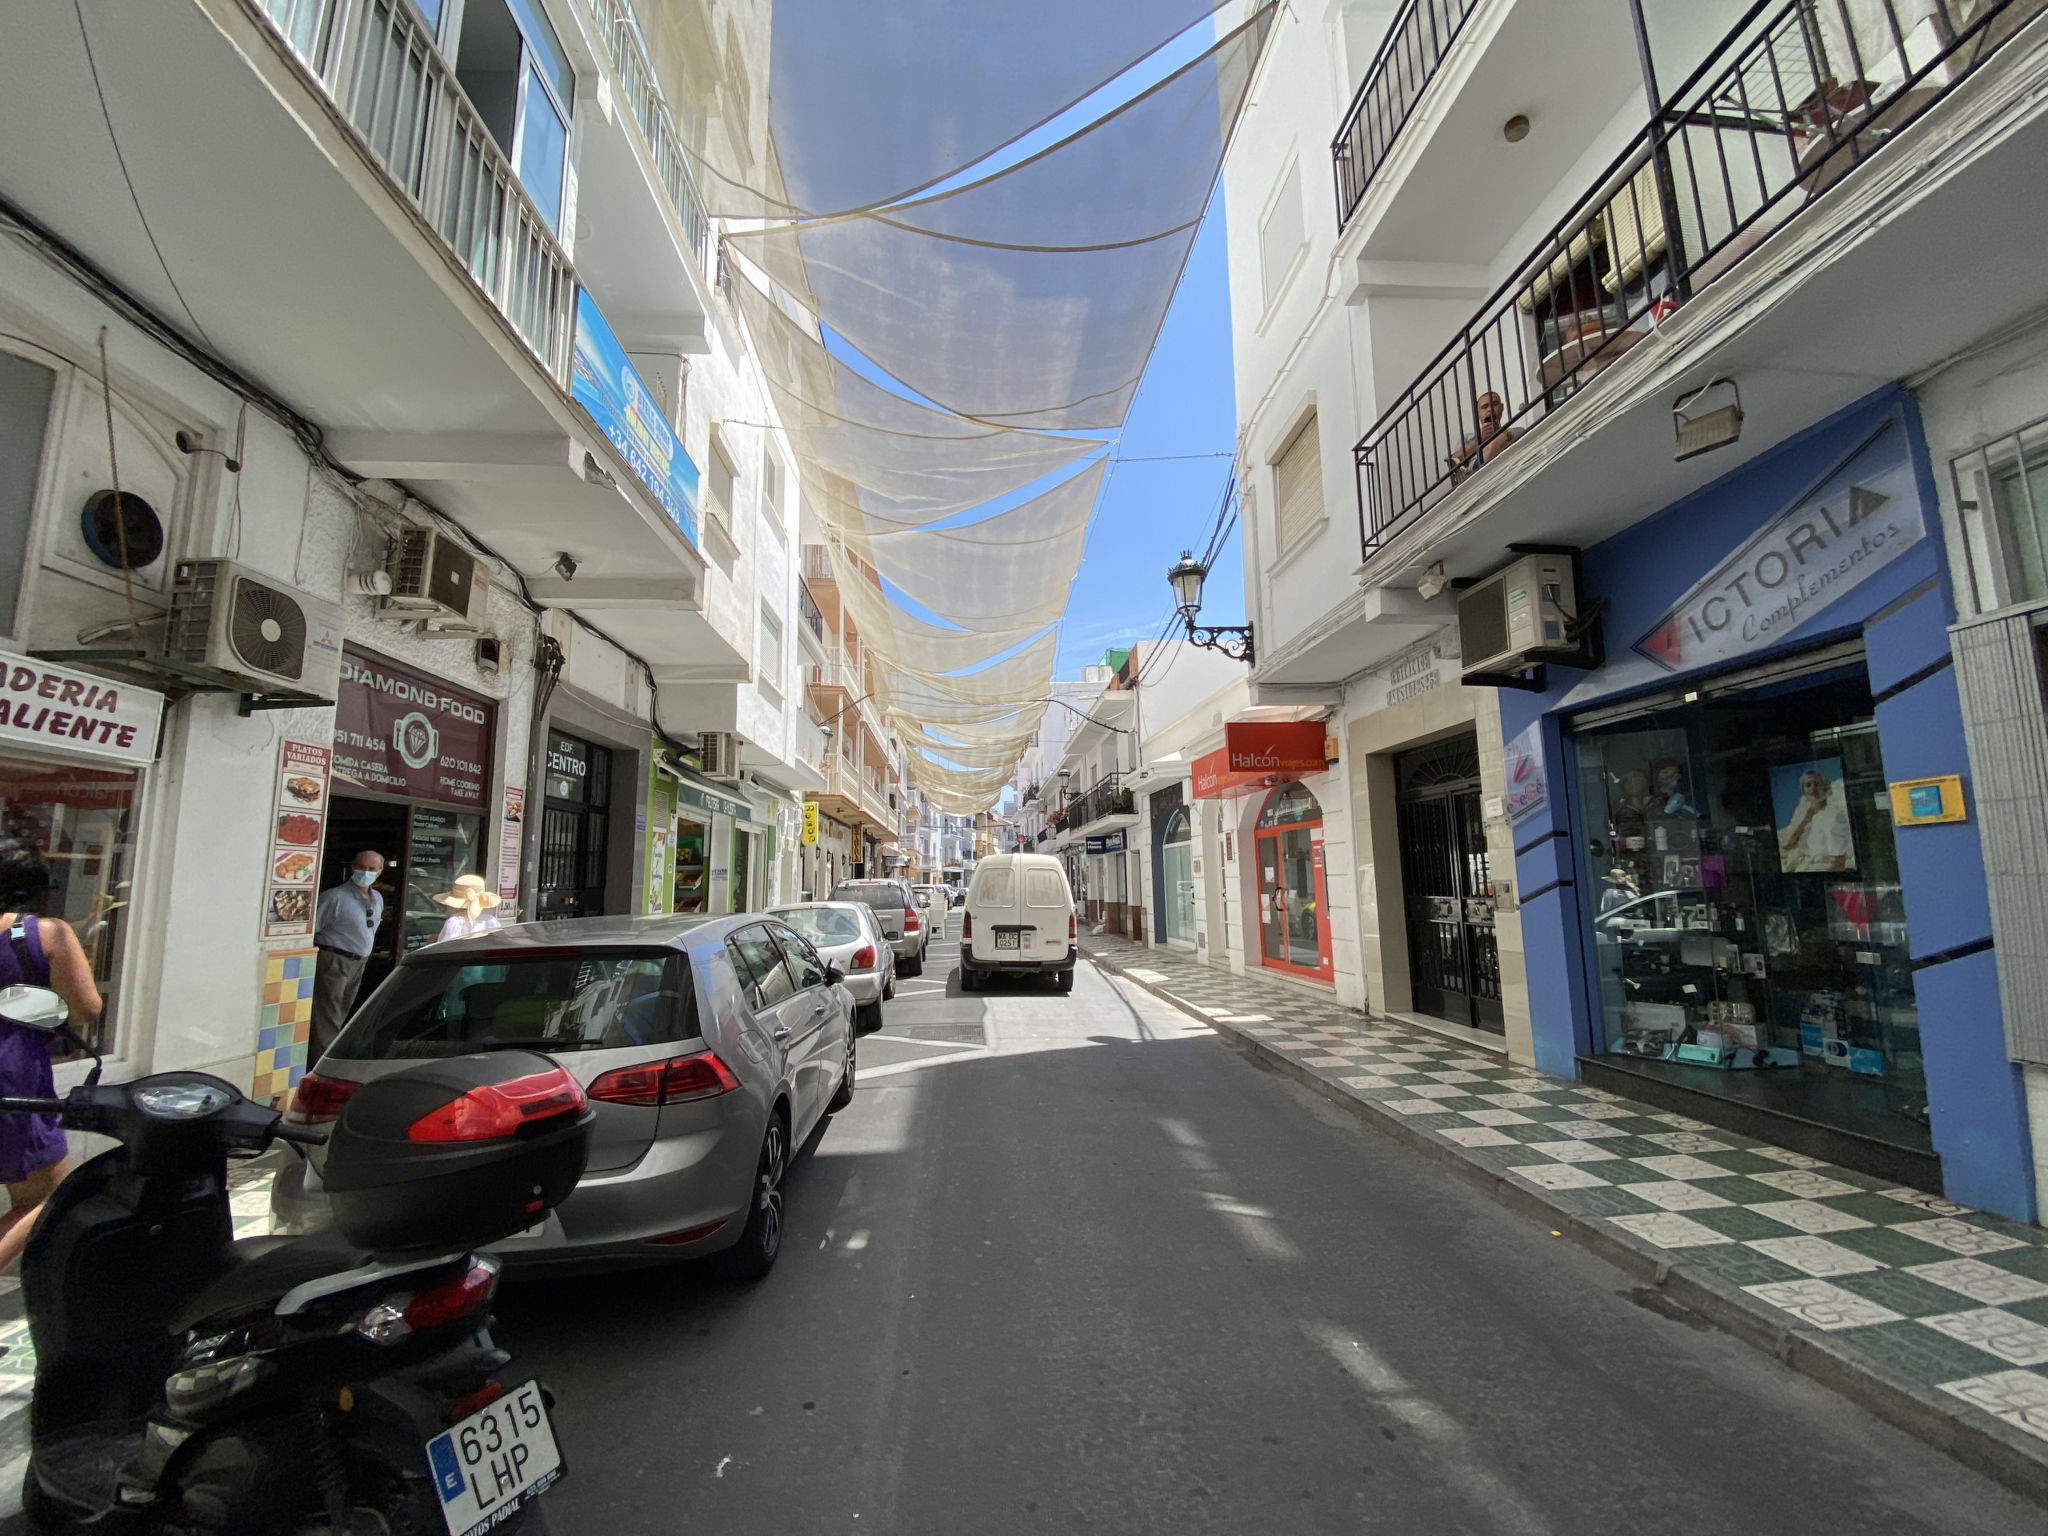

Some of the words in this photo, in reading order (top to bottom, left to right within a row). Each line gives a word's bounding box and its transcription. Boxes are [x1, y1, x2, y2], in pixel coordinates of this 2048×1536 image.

[608, 424, 628, 457] +34
[630, 450, 648, 481] 642
[649, 474, 665, 507] 194
[1741, 522, 1901, 643] Complementos
[440, 698, 485, 724] FOOD
[292, 744, 323, 756] PLATOS
[351, 733, 363, 747] 711
[366, 736, 386, 752] 454
[287, 751, 327, 765] VARIADOS
[333, 755, 359, 768] OMIDA
[361, 758, 388, 774] CASERA
[333, 766, 363, 779] NTREGA
[460, 1391, 540, 1465] 6315
[445, 1471, 457, 1489] E
[470, 1443, 529, 1510] LHP
[463, 1518, 490, 1536] OTOS
[491, 1497, 521, 1527] PADIAL
